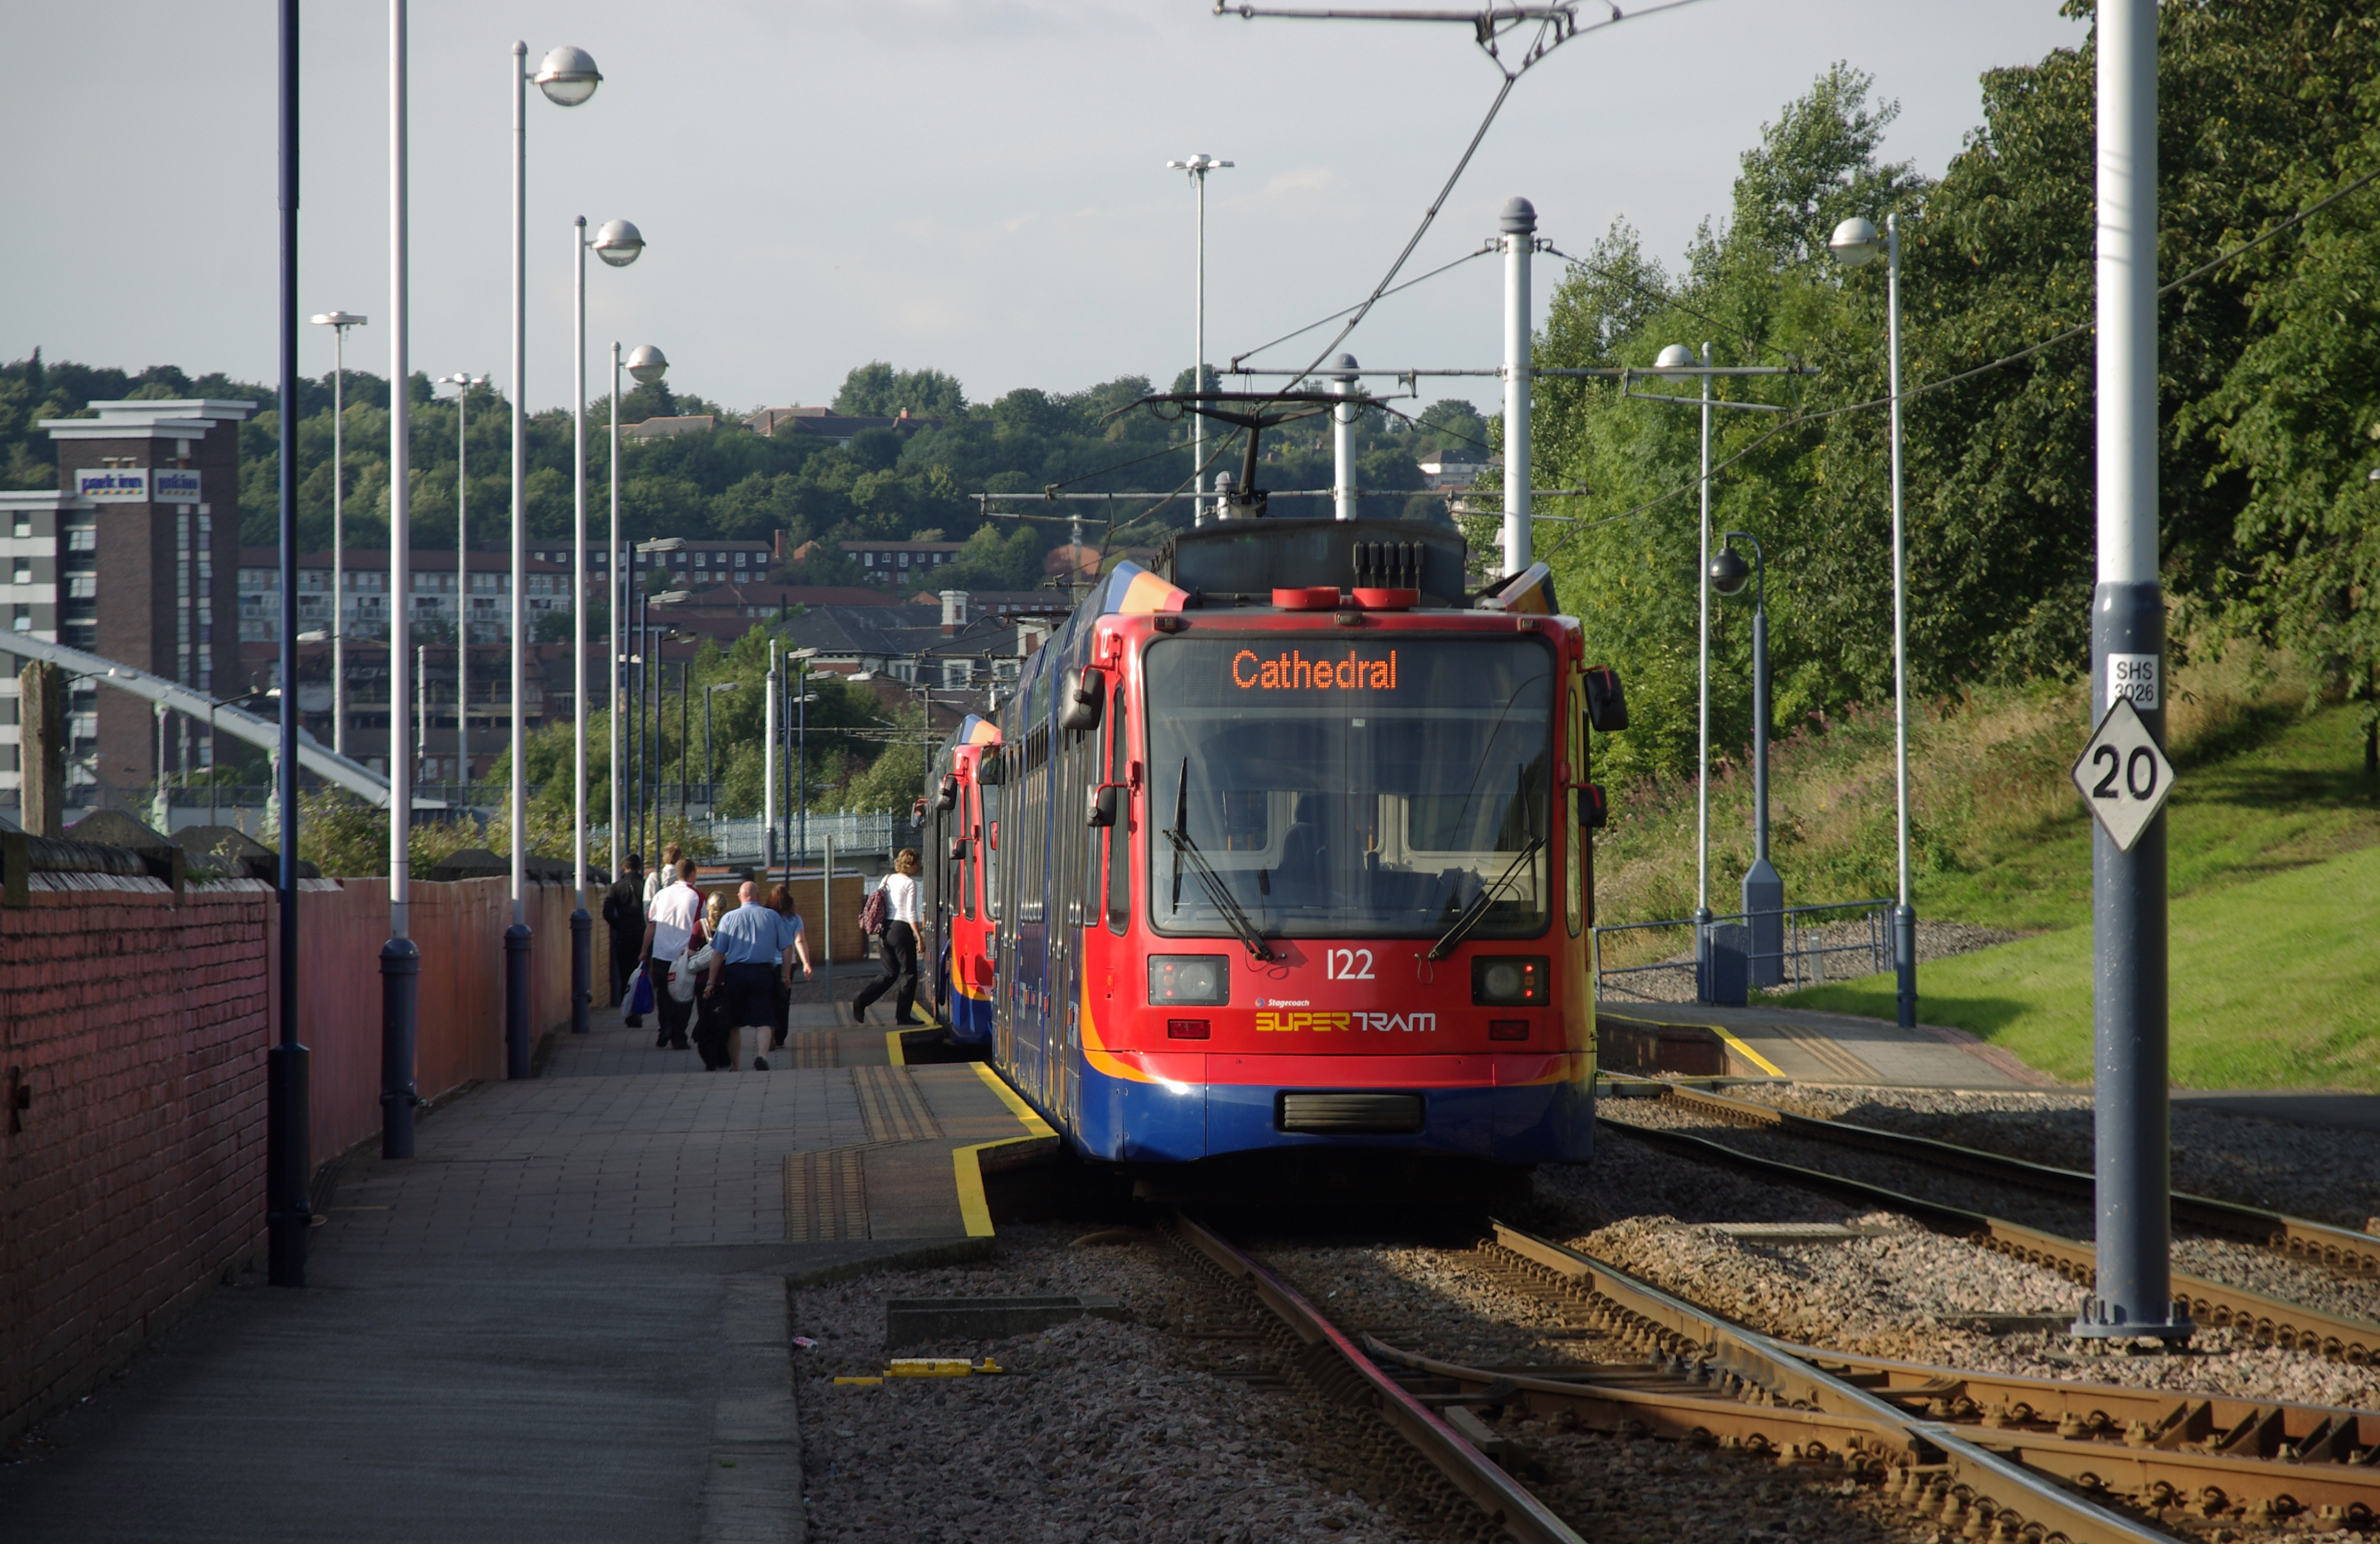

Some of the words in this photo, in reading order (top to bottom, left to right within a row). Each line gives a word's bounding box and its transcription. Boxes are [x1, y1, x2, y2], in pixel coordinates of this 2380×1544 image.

[82, 474, 114, 494] park
[118, 474, 143, 488] inn
[1232, 650, 1397, 689] Cathedral
[2117, 661, 2152, 680] SHS
[2093, 744, 2158, 800] 20
[1328, 949, 1375, 979] 122
[1268, 999, 1310, 1008] Stagecoach
